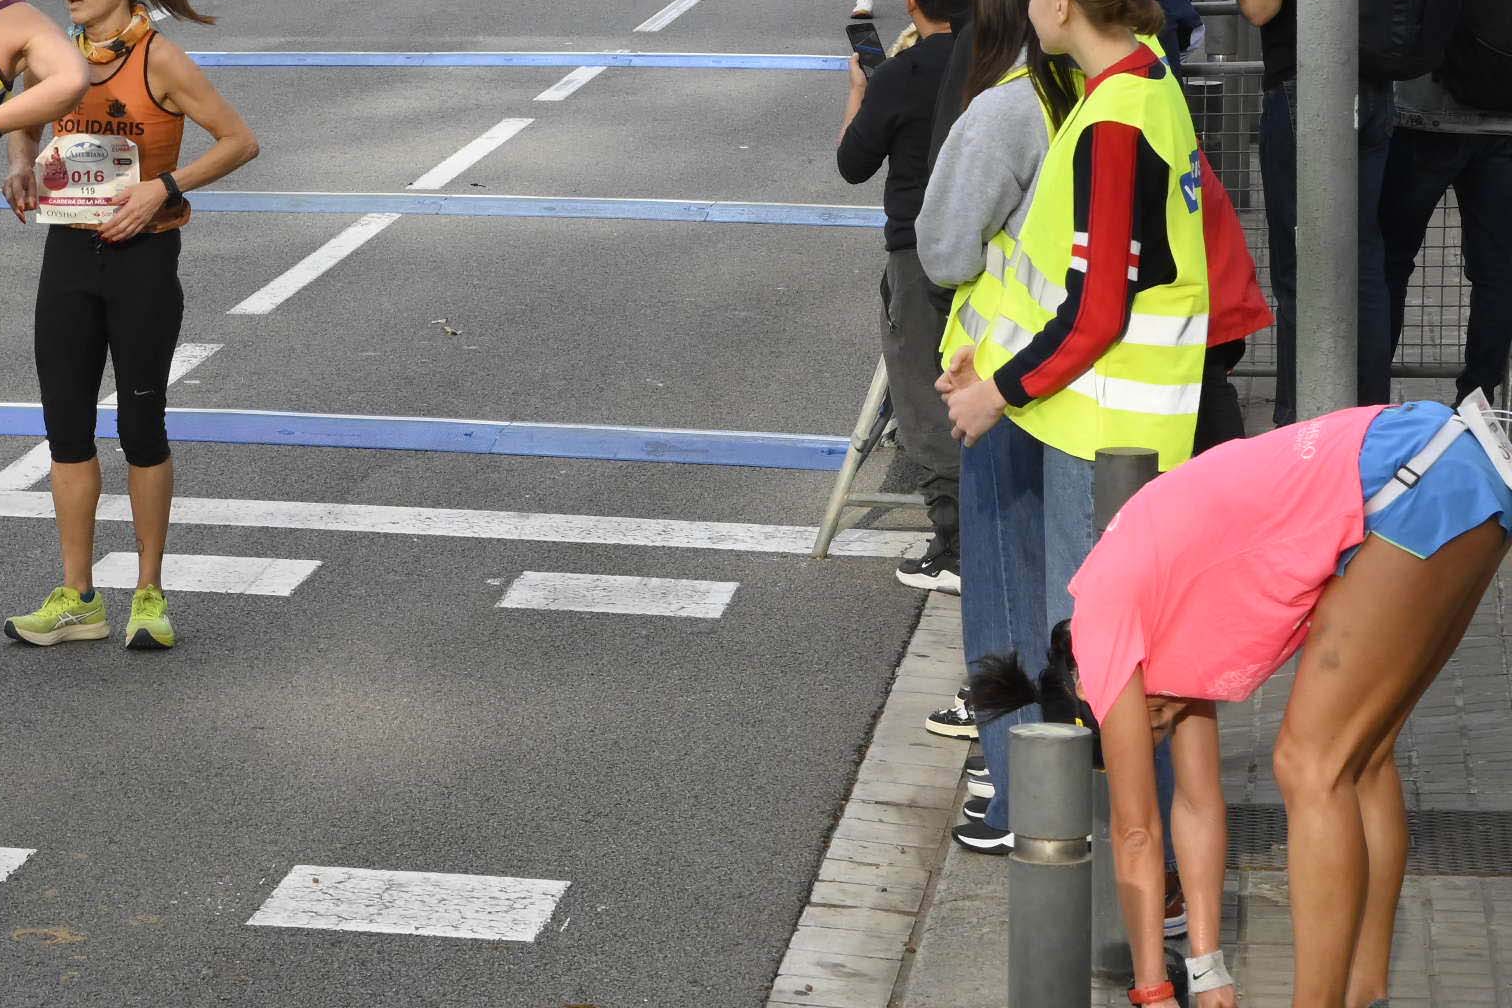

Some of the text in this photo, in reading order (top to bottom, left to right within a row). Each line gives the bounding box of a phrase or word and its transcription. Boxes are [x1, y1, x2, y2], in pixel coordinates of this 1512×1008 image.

[57, 119, 146, 136] SOLIDARIS
[71, 170, 105, 183] 016
[81, 187, 96, 196] 119
